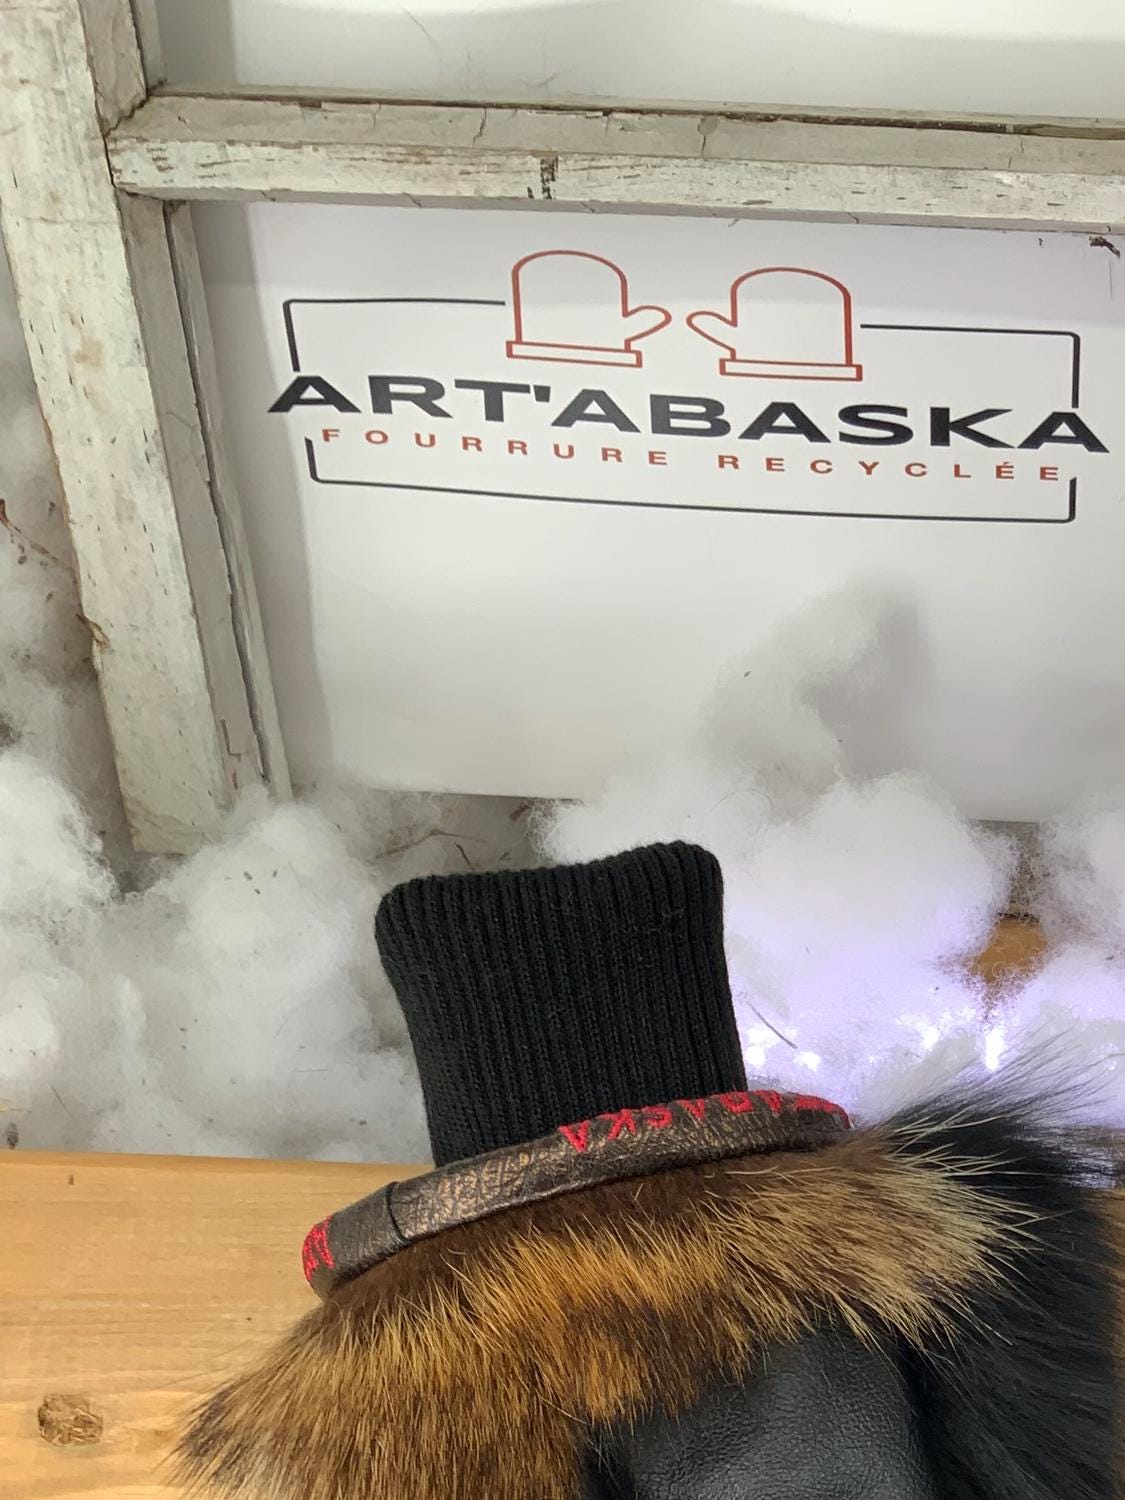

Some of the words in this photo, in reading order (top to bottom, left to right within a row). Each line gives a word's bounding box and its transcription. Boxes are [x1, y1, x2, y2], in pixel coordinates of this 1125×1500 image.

[268, 373, 1110, 454] ART'ABASKA
[321, 427, 669, 466] FOURRURE
[717, 455, 1063, 482] RECYCLÉE
